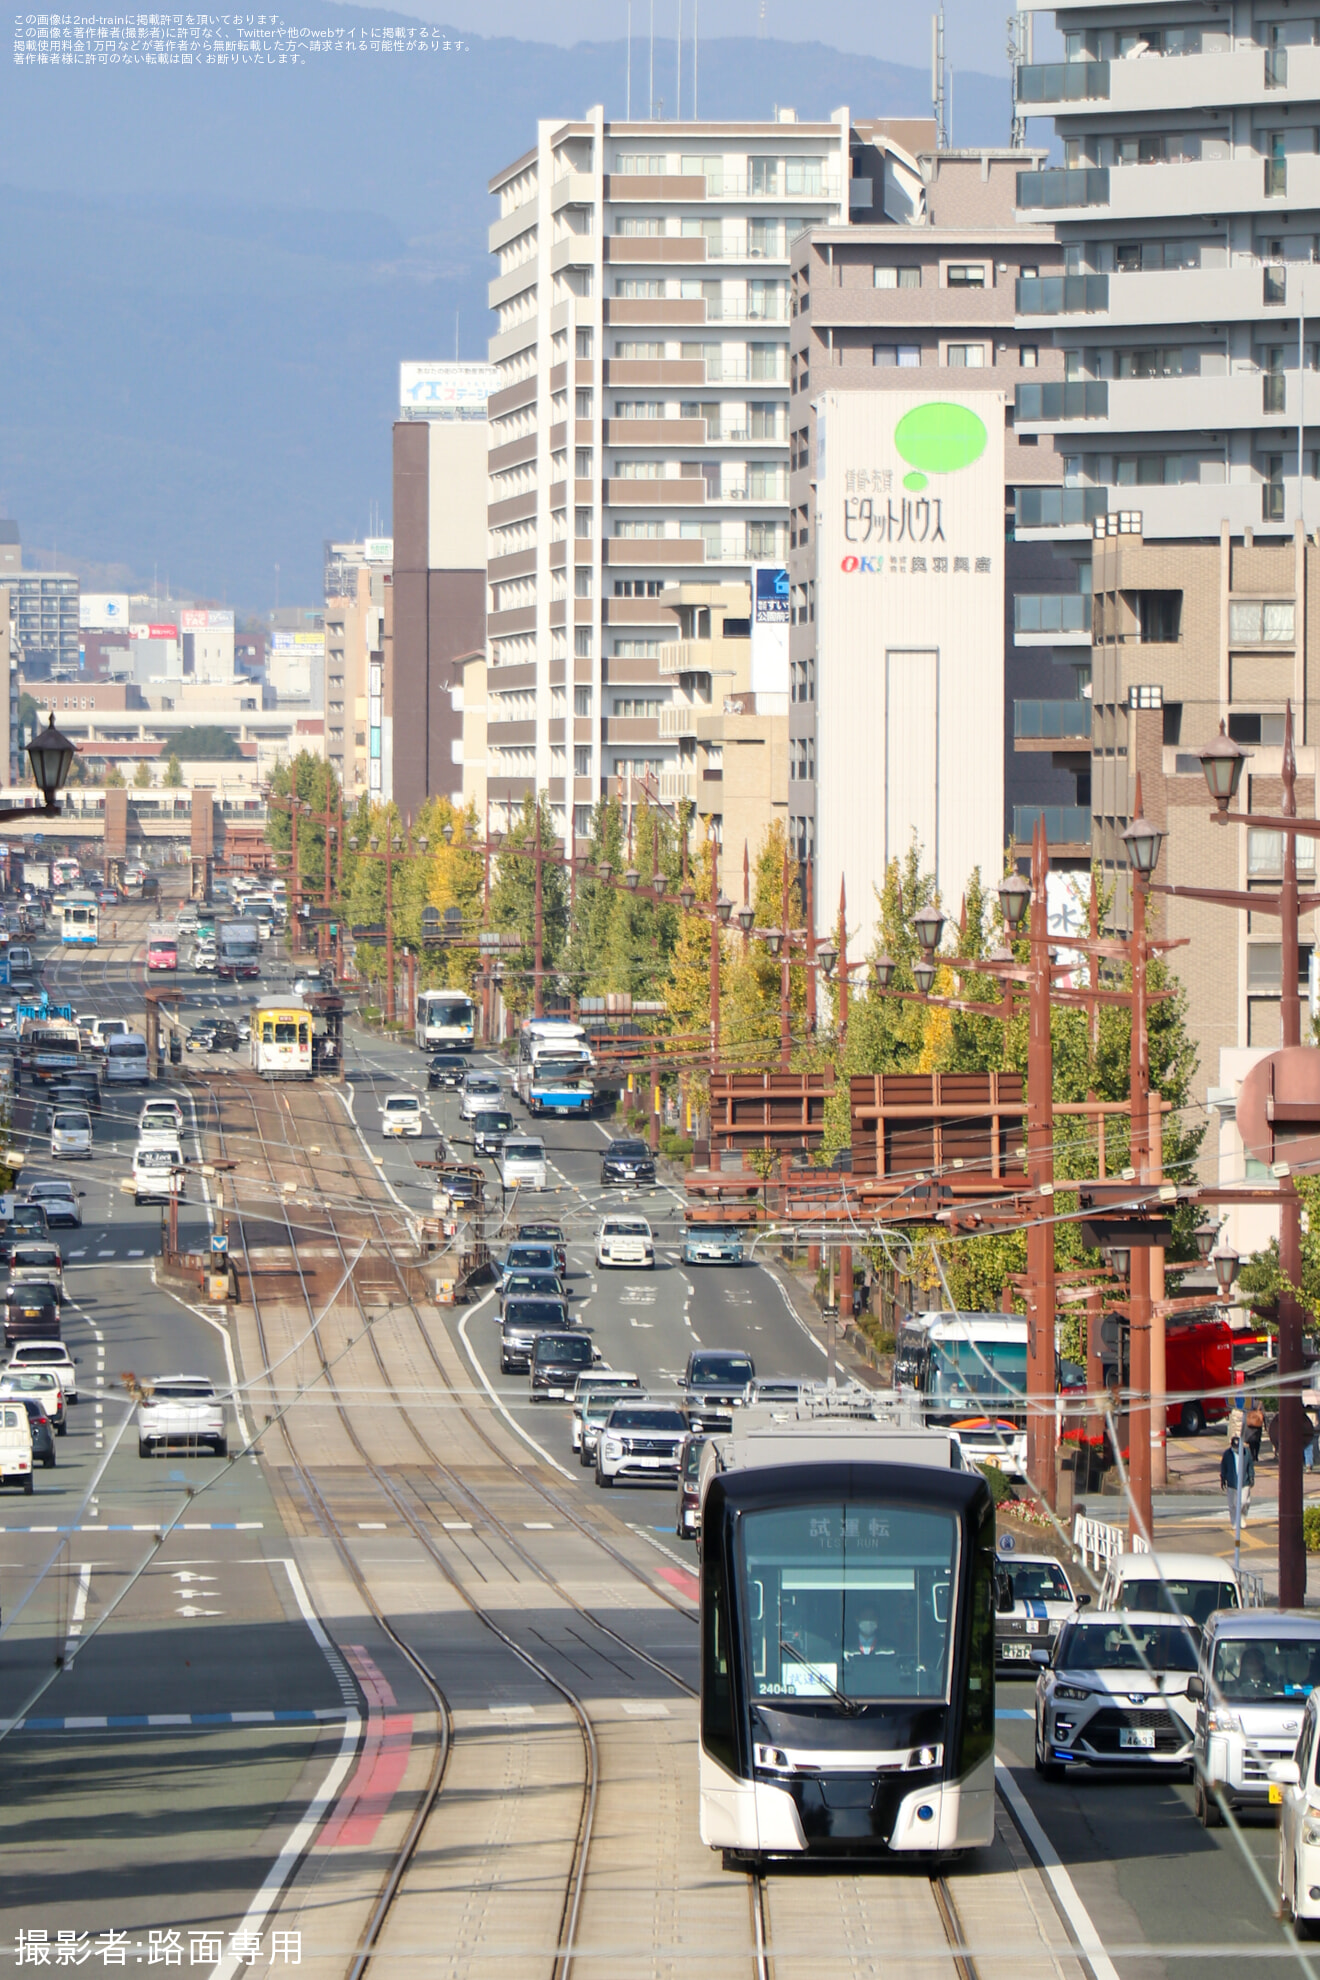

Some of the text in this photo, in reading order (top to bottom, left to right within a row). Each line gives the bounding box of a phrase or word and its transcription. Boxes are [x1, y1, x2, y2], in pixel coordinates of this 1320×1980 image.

[844, 497, 946, 542] ピタットハウス
[841, 555, 884, 573] OK!
[809, 1518, 889, 1537] 試運転
